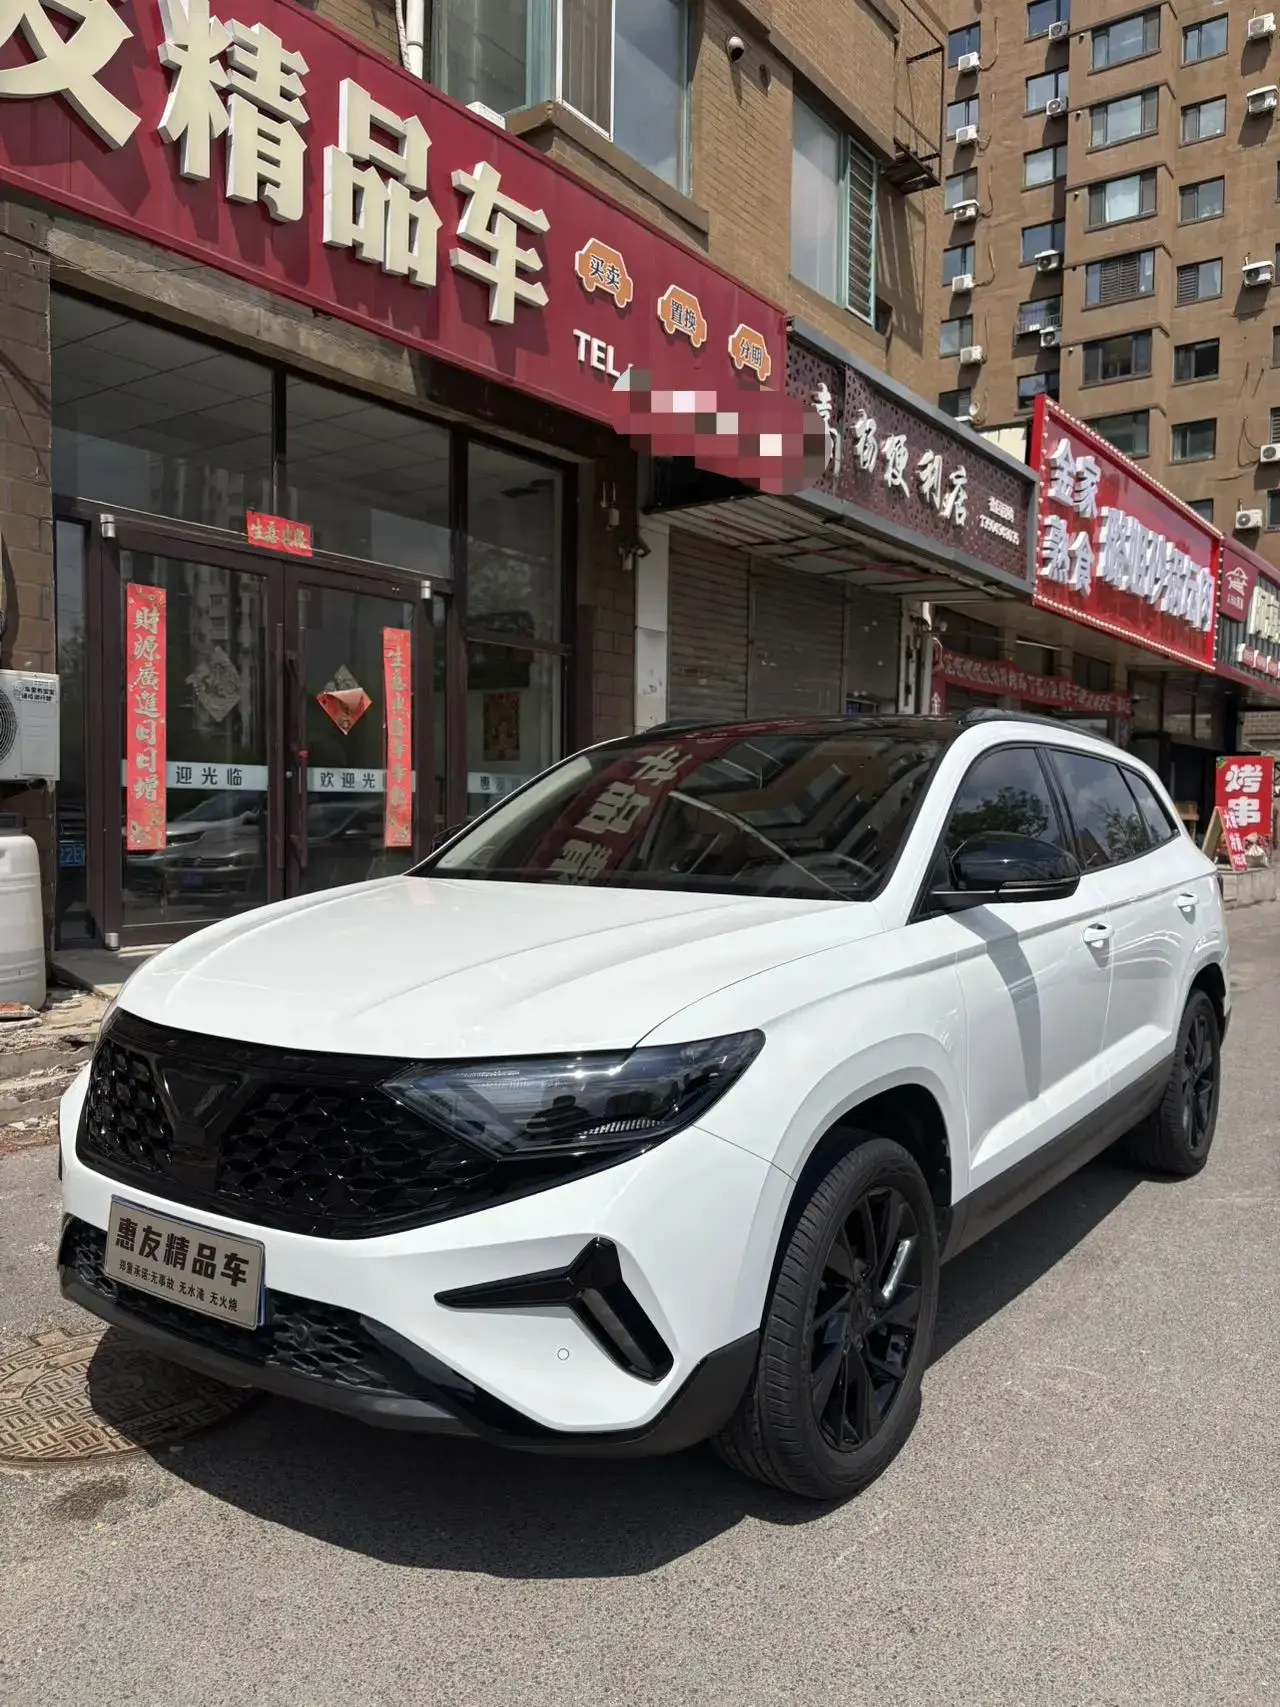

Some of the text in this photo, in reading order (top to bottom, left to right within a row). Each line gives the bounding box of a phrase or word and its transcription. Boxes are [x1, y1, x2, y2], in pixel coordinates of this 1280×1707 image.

[589, 254, 763, 368] 买卖 置换 分期
[1040, 515, 1095, 597] 熟食
[175, 766, 243, 787] 迎光临
[320, 770, 386, 790] 欢迎光
[1224, 764, 1264, 826] 烤串
[115, 1217, 250, 1287] 惠友精品车
[208, 1291, 239, 1313] 无火烧
